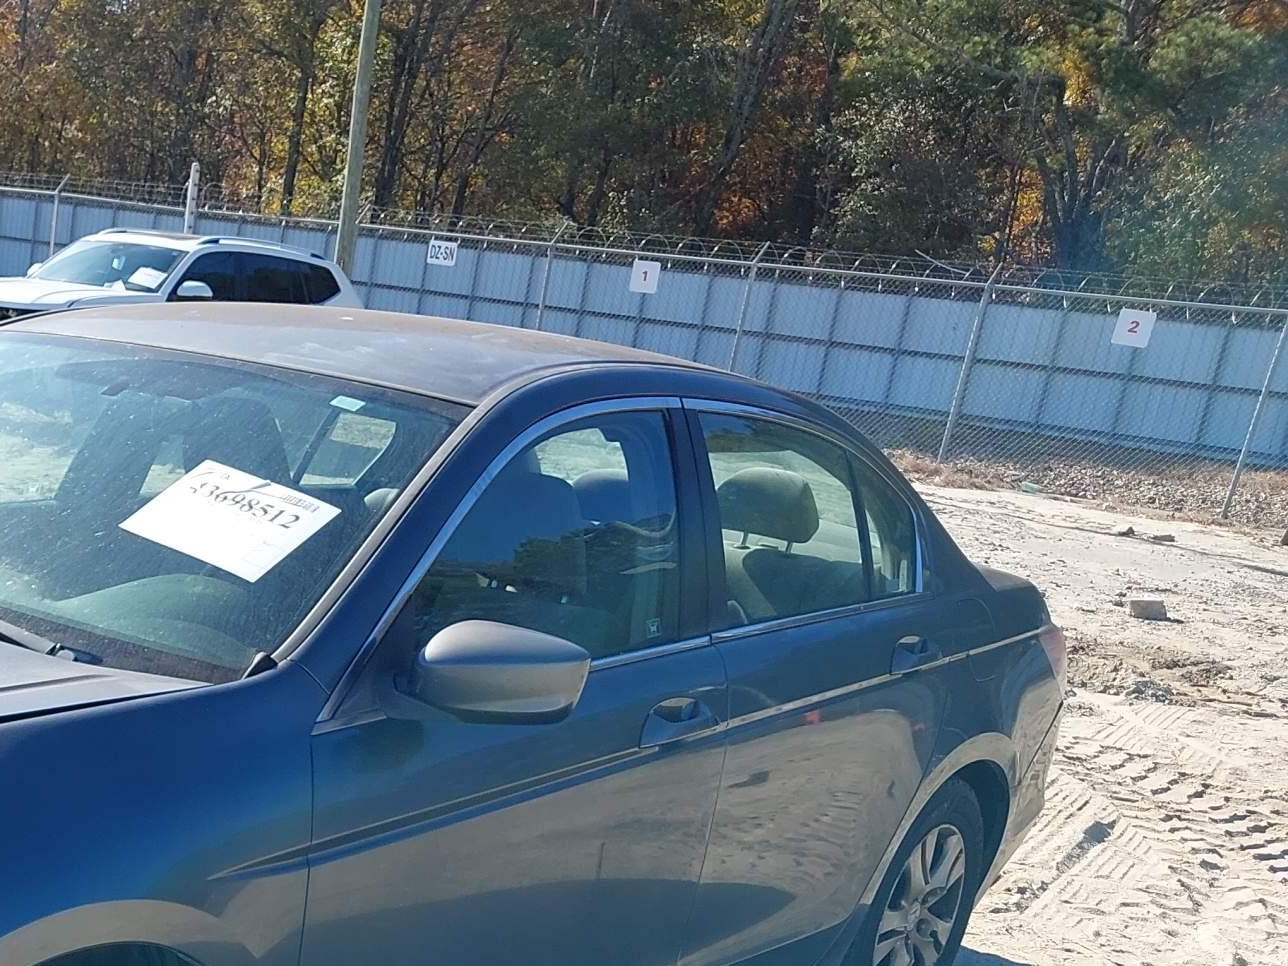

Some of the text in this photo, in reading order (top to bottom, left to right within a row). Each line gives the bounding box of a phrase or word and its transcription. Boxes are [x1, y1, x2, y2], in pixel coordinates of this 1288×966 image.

[429, 244, 456, 262] DZ-SN
[642, 270, 648, 281] 1
[1127, 320, 1140, 334] 2
